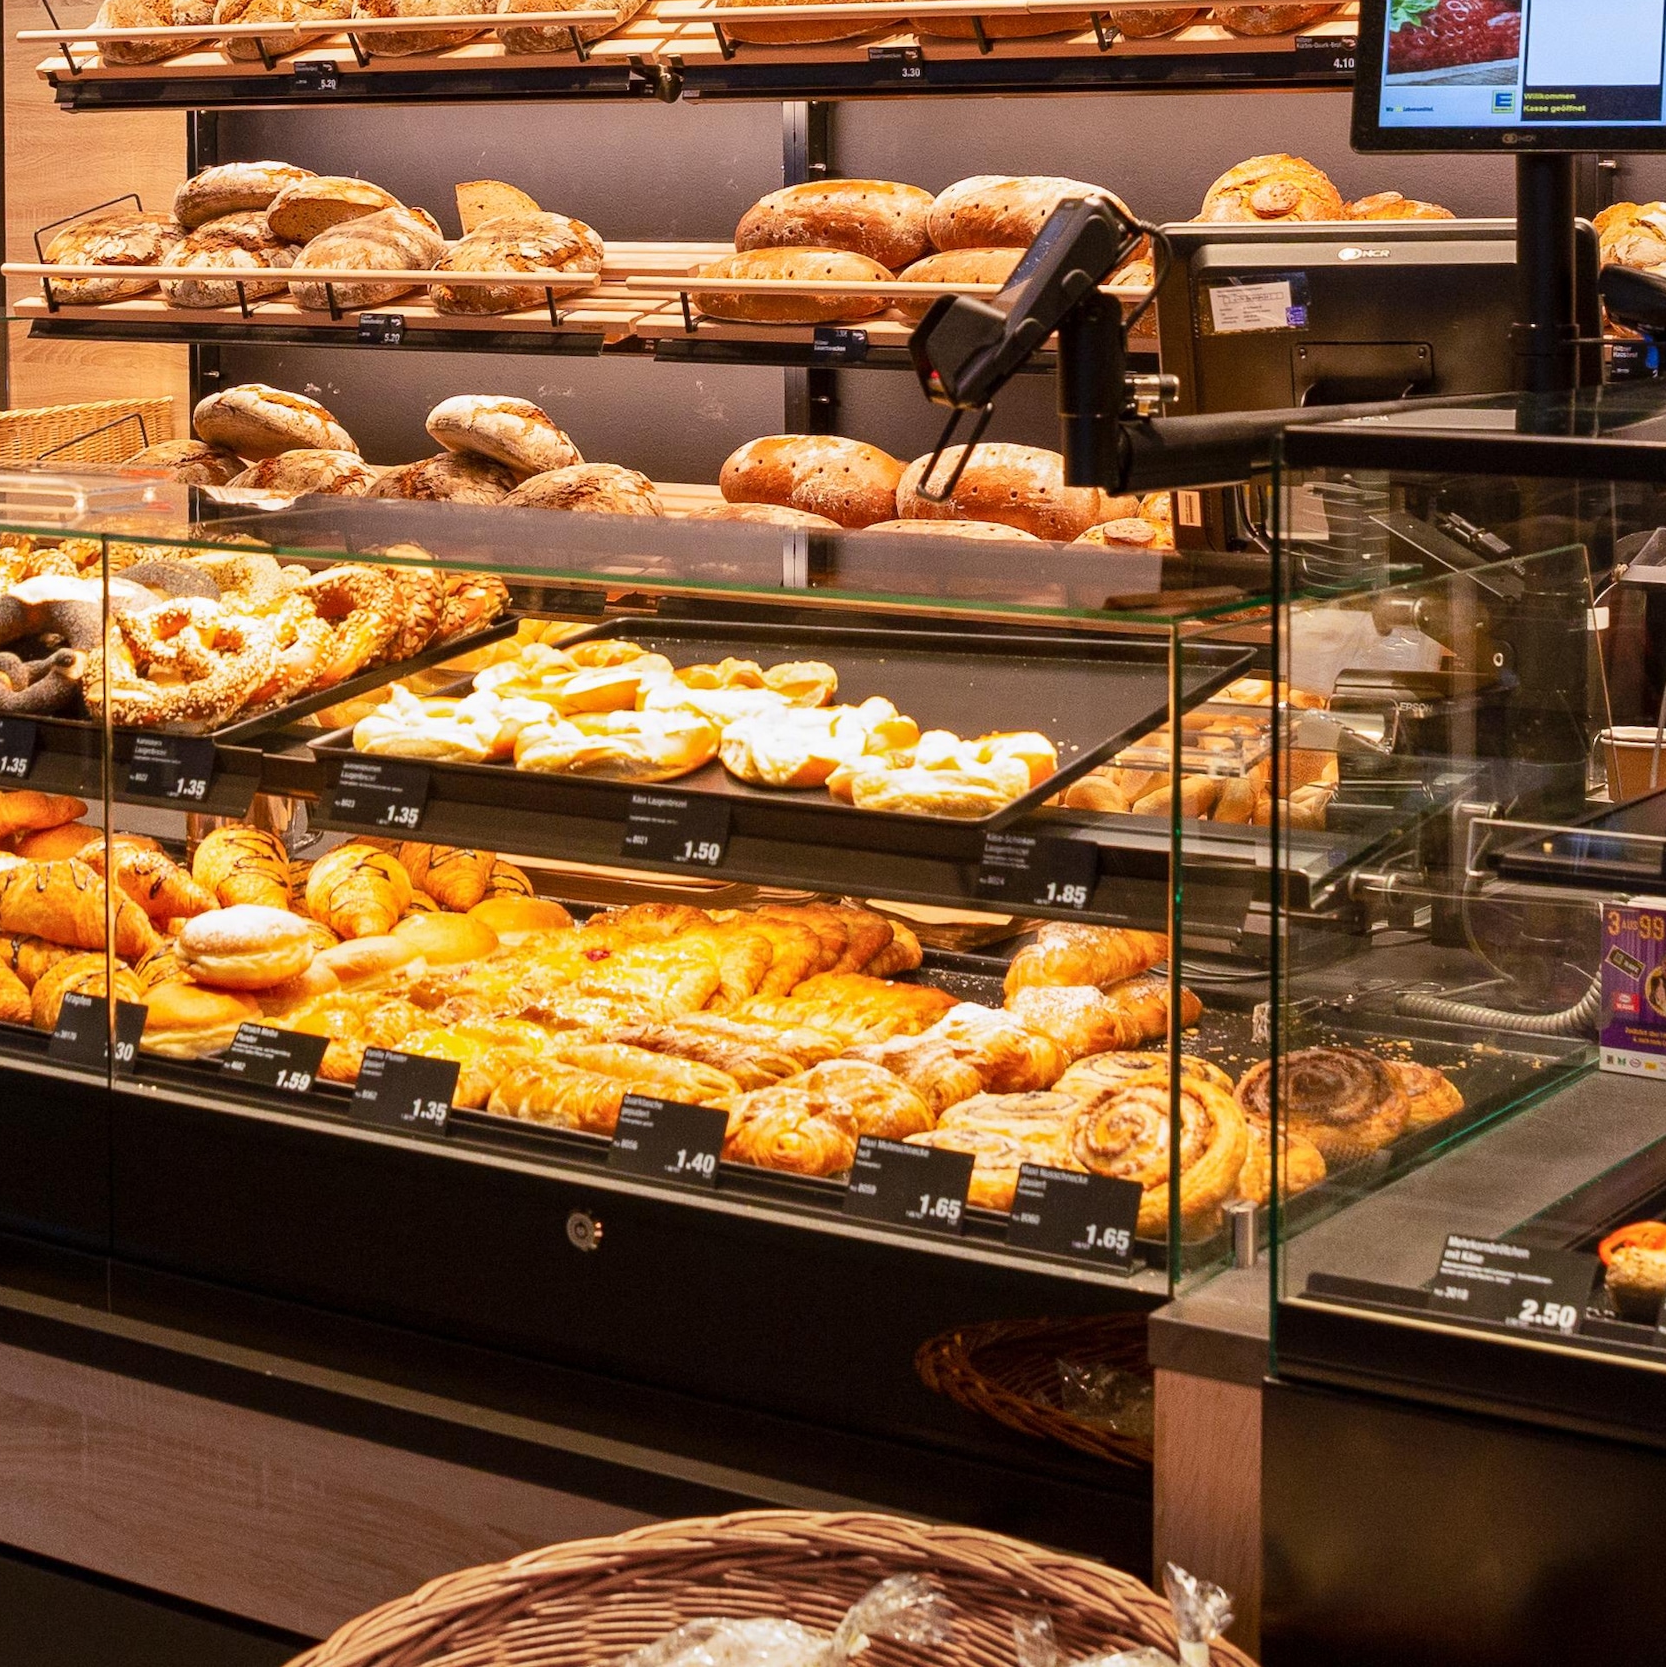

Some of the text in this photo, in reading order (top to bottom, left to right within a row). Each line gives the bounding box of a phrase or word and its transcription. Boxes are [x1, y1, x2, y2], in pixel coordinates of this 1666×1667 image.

[901, 67, 921, 78] 3.30
[1333, 57, 1356, 69] 4.10
[320, 79, 337, 89] 5.20
[1523, 91, 1576, 100] Willkommen
[1523, 104, 1587, 114] Kasse geöffnet
[1361, 248, 1391, 258] NCR
[384, 333, 401, 342] 5.20
[1399, 701, 1433, 713] EPSON
[0, 756, 27, 775] 1.35
[176, 777, 207, 797] 1.35
[386, 805, 420, 825] 1.35
[683, 840, 720, 861] 1.50
[1046, 882, 1088, 906] 1.85
[1607, 910, 1621, 937] 3
[1621, 920, 1639, 932] AUS
[1638, 914, 1666, 942] 99
[64, 993, 93, 1008] Krapfen
[275, 1069, 311, 1092] 1.59
[412, 1098, 448, 1122] 1.35
[676, 1149, 716, 1175] 1.40
[919, 1193, 962, 1221] 1.65
[1085, 1223, 1131, 1252] 1.65
[1517, 1298, 1578, 1329] 2.50
